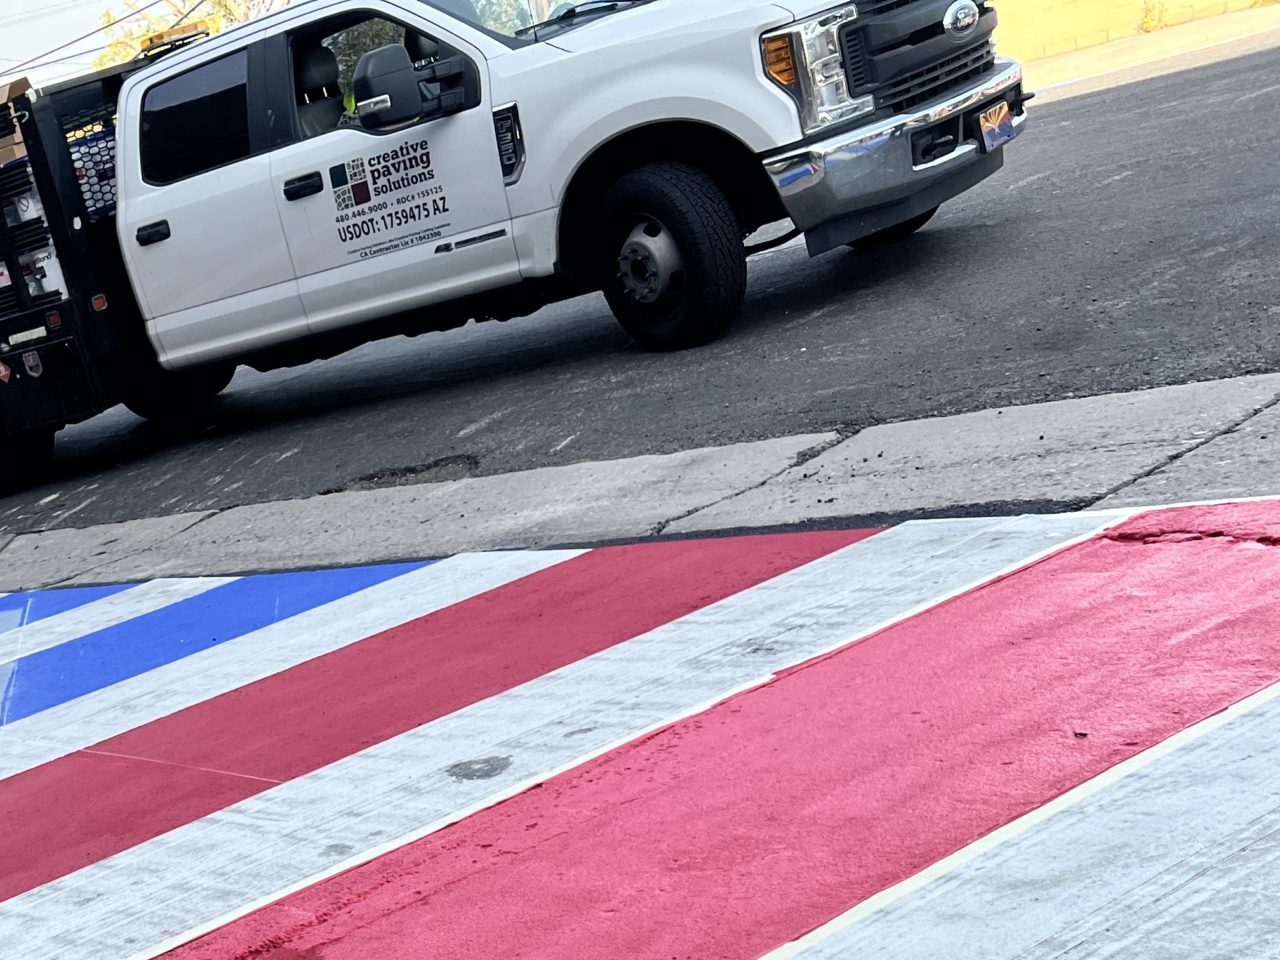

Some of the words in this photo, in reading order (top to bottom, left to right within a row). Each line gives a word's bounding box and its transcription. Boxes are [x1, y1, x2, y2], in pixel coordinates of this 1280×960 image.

[367, 139, 428, 167] creative
[370, 150, 431, 185] paving
[373, 168, 435, 196] solutions
[335, 202, 388, 223] 480.446.9000
[416, 185, 443, 199] 155125
[337, 219, 381, 243] USDOT:
[381, 202, 430, 231] 1759475
[432, 196, 449, 216] AZ
